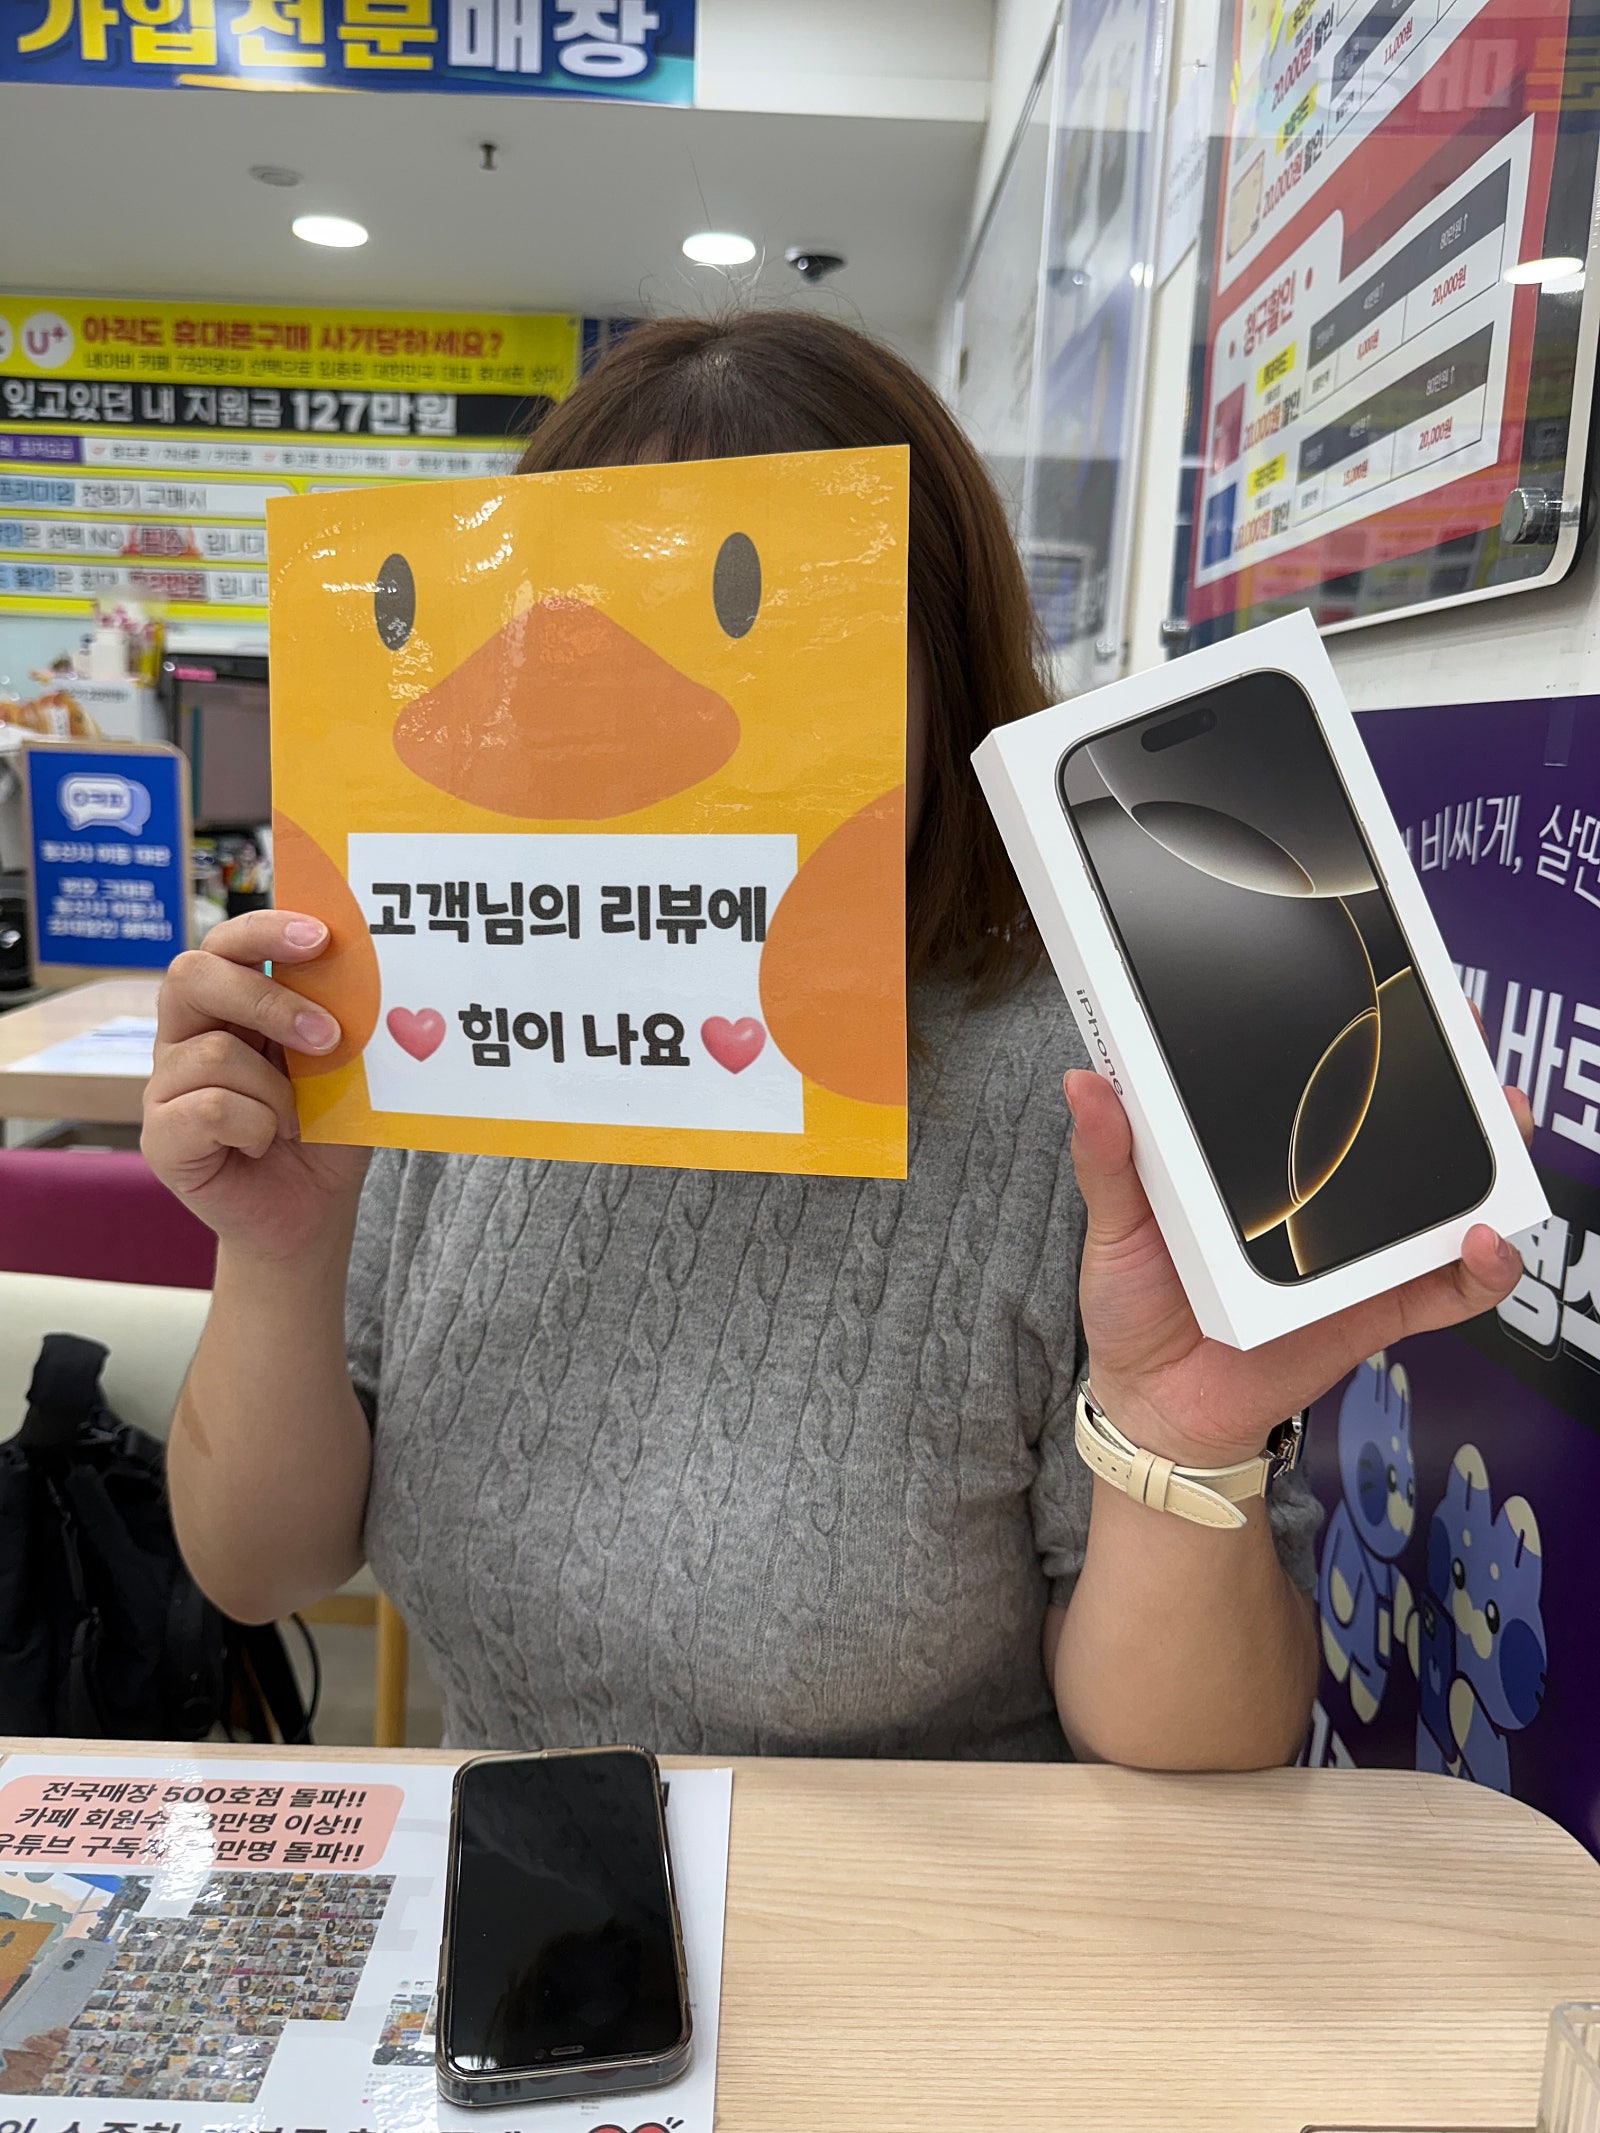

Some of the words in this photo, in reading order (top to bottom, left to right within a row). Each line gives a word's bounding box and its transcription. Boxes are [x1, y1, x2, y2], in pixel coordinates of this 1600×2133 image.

[1431, 264, 1467, 307] 20,000원
[82, 316, 164, 347] 아직도
[3, 379, 135, 424] 잊고있던
[141, 384, 176, 425] 내
[183, 387, 283, 429] 지원금
[292, 391, 458, 437] 127만원
[1418, 416, 1453, 451] 20,000원
[91, 526, 126, 551] NO
[1421, 794, 1523, 875] 비싸게,
[369, 881, 580, 945] 고객님의
[601, 883, 767, 945] 리뷰에
[458, 1002, 565, 1067] 힘이
[582, 1012, 691, 1067] 나요
[1076, 989, 1123, 1096] iPhone
[42, 1781, 158, 1804] 전국매장
[161, 1785, 285, 1807] 500호점
[289, 1788, 367, 1809] 돌파!!
[15, 1807, 79, 1830] 카페
[80, 1808, 169, 1832] 회원수
[191, 1812, 277, 1834] 3만명
[284, 1813, 363, 1836] 이상!!
[282, 1842, 365, 1864] 돌파!!
